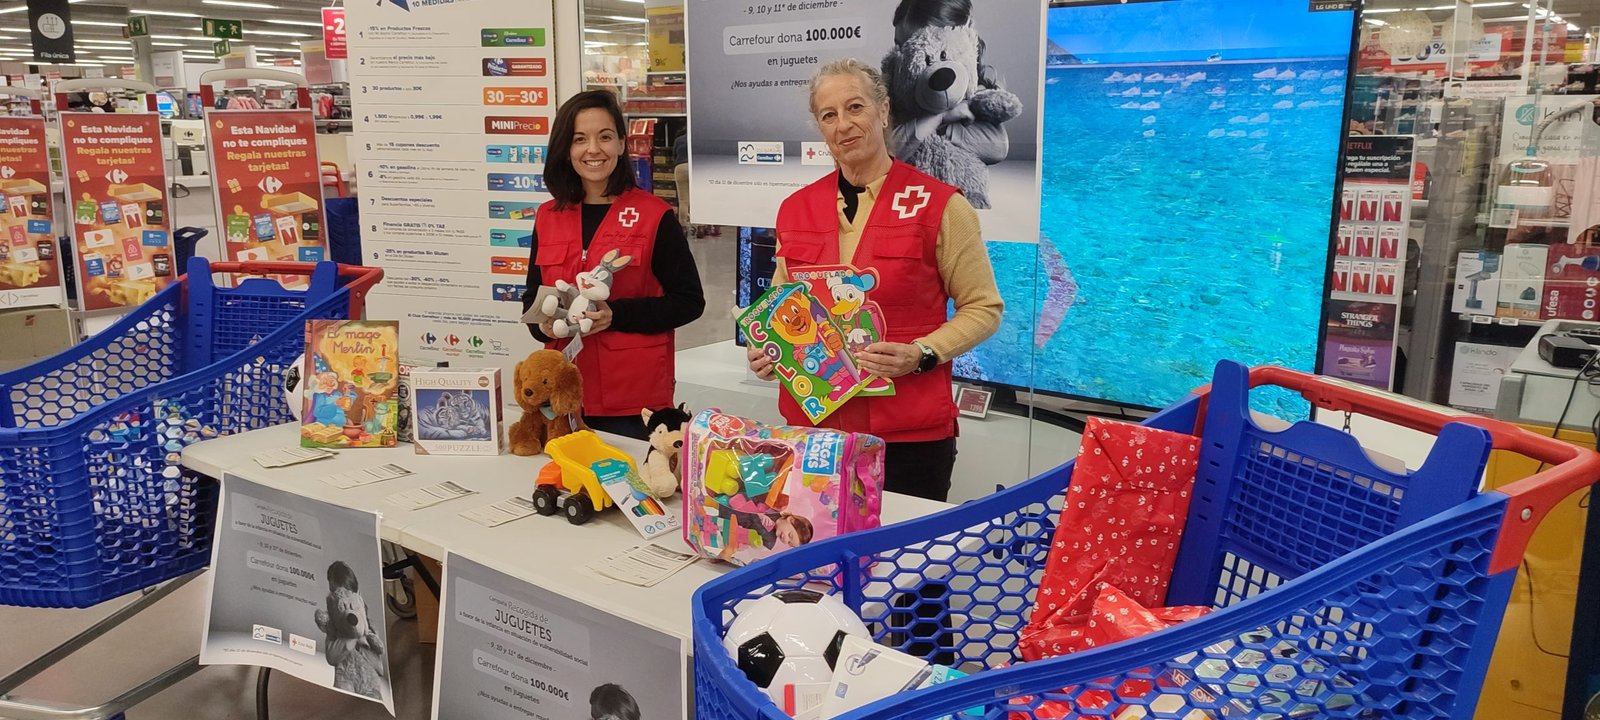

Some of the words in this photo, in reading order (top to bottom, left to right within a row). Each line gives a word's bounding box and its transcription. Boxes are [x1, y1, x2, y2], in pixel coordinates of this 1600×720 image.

[757, 6, 766, 14] 10
[767, 6, 772, 15] y
[798, 0, 838, 10] diciembre
[730, 35, 775, 47] Carrefour
[777, 33, 803, 43] dona
[806, 26, 861, 41] 100.000€
[780, 56, 818, 67] juguetes
[730, 80, 747, 90] ¿Nos
[748, 80, 773, 89] ayudas
[486, 90, 504, 103] 30
[520, 90, 543, 103] 30€
[231, 126, 253, 134] Esta
[255, 125, 296, 134] Navidad
[99, 136, 153, 145] compliques
[251, 137, 307, 148] compliques
[76, 147, 110, 156] Regala
[227, 151, 262, 162] Regala
[264, 150, 306, 159] nuestras
[96, 157, 135, 166] tarjetas!
[248, 162, 289, 172] tarjetas!
[509, 176, 538, 189] -10%
[792, 270, 854, 280] TROQUELADO
[1546, 290, 1559, 317] ufesa
[1341, 312, 1378, 322] STRANGER
[1346, 320, 1373, 328] THINGS
[328, 327, 340, 338] El
[345, 331, 382, 344] mago
[749, 321, 826, 418] COLOR
[819, 432, 835, 469] MEGA
[261, 514, 298, 534] JUGUETES
[507, 601, 538, 620] Recogida
[539, 612, 549, 624] de
[495, 609, 552, 642] JUGUETES
[525, 656, 552, 672] diciembre
[477, 657, 509, 676] Carrefour
[511, 672, 529, 684] dona
[530, 678, 569, 700] 100.000€
[491, 695, 508, 706] ayudas
[513, 689, 540, 704] juguetes
